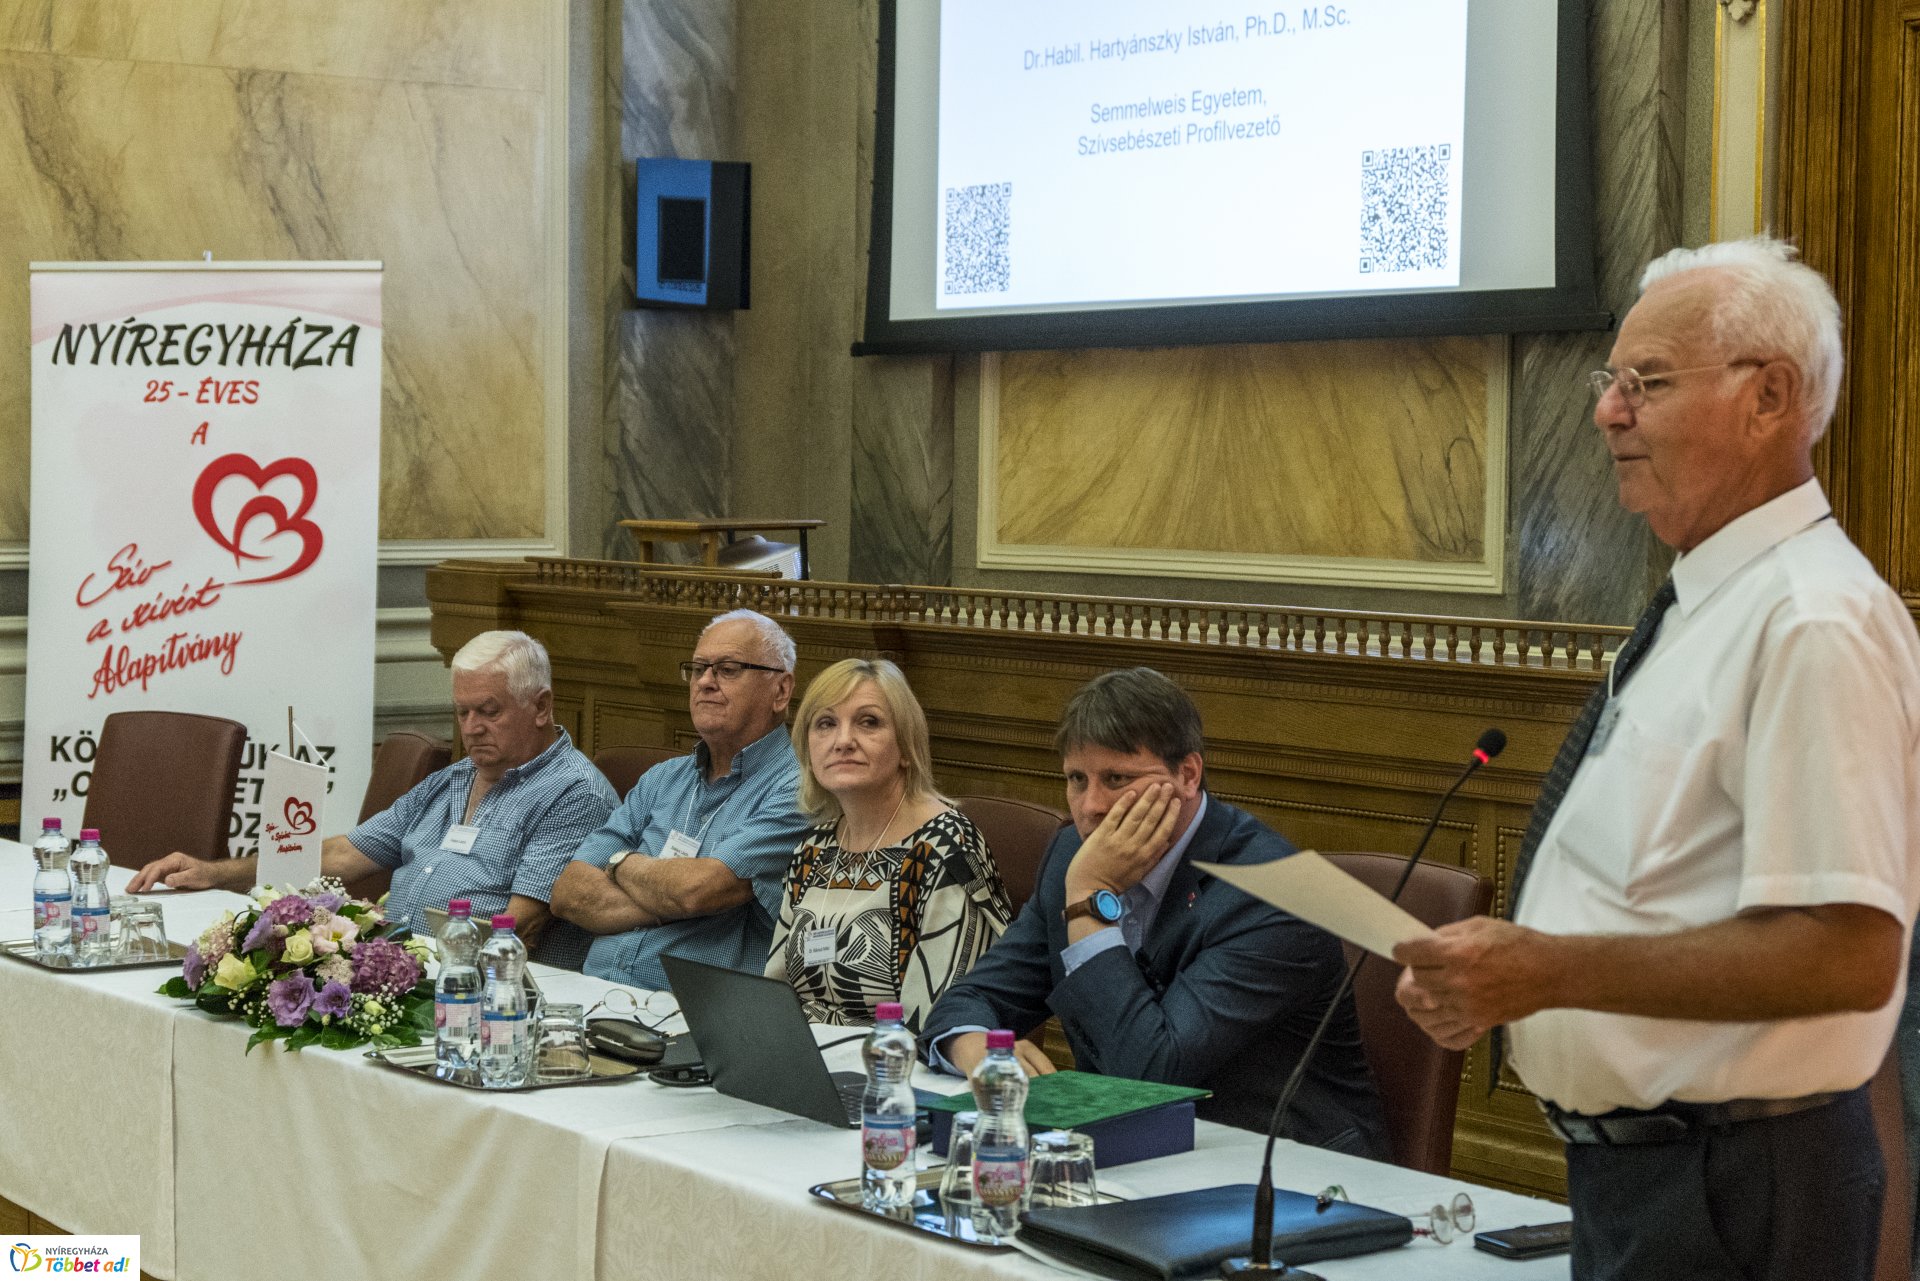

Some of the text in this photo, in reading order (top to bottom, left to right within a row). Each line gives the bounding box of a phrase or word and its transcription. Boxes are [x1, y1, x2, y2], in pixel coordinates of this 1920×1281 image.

[1090, 28, 1183, 62] Hartyánszky
[1188, 20, 1240, 46] István,
[1245, 12, 1297, 38] Ph.D.,
[1303, 5, 1351, 31] M.Sc.
[1090, 87, 1267, 124] Semmelweis Egyetem,
[1077, 114, 1281, 156] Szívsebészeti Profilvezető
[51, 317, 361, 371] NYÍREGYHÁZA
[143, 380, 174, 404] 25
[195, 376, 260, 405] ÉVES
[190, 421, 210, 445] A
[86, 618, 112, 643] a
[87, 631, 243, 698] Alapítvány
